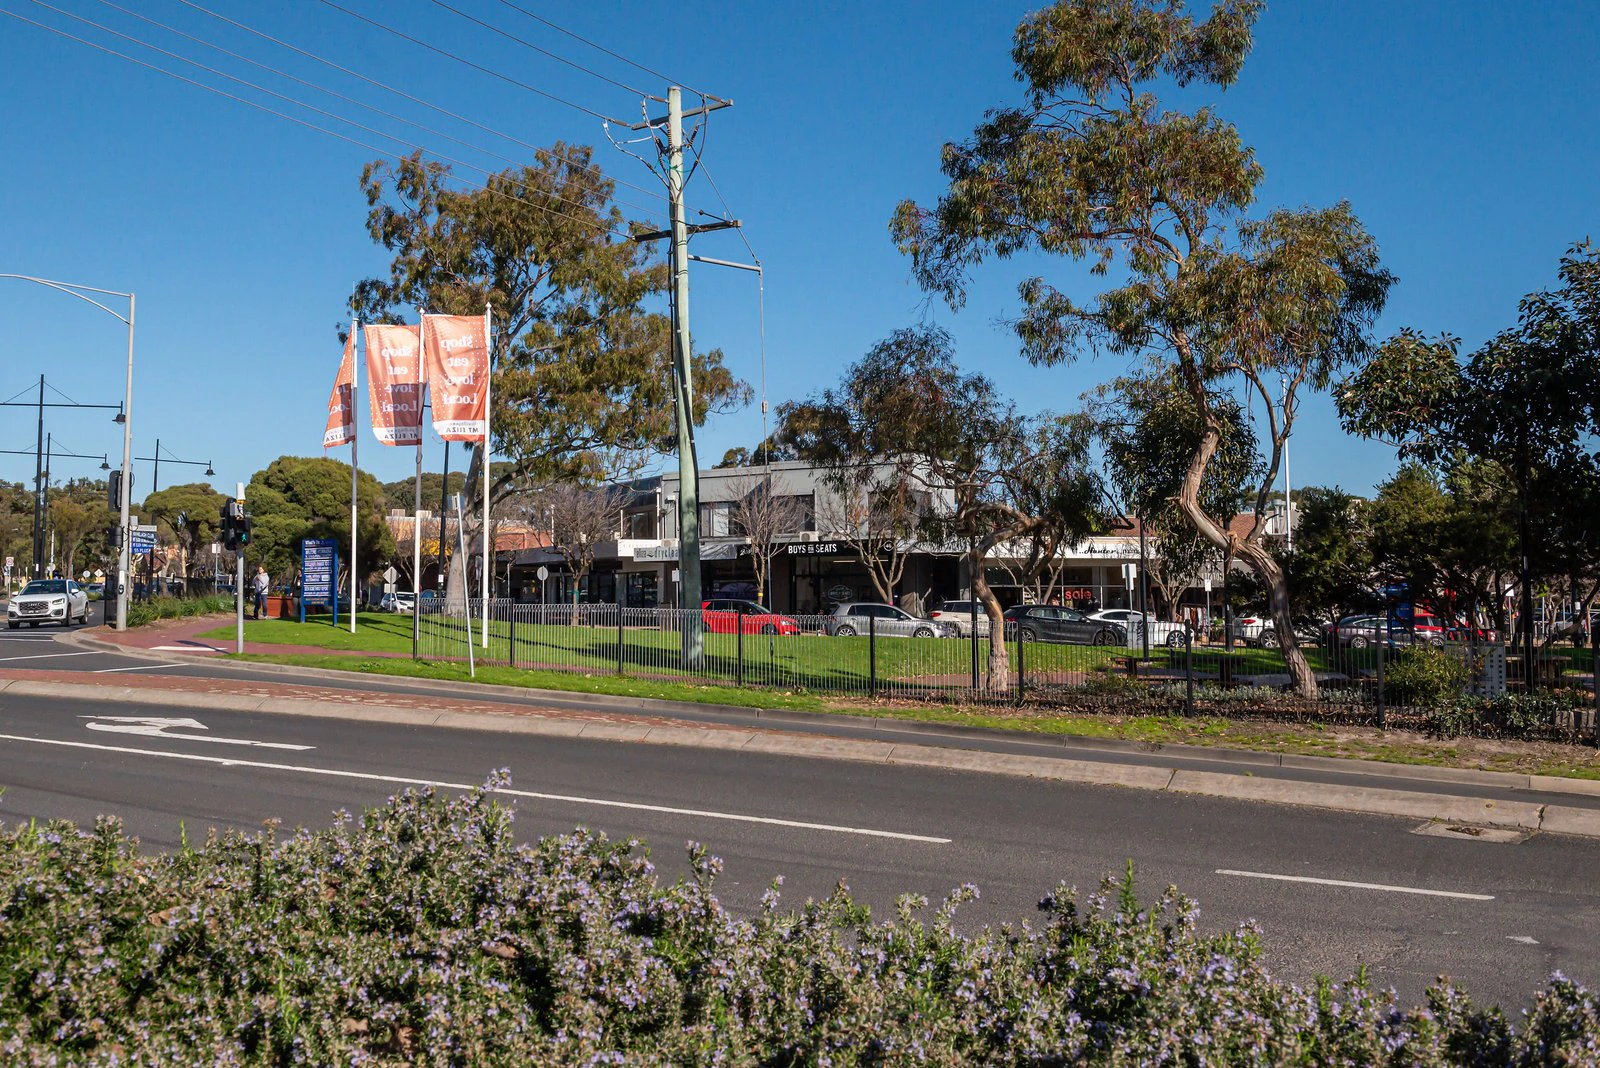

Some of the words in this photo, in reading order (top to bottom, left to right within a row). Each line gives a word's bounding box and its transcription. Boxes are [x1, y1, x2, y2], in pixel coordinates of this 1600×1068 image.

[655, 546, 678, 559] dryclea
[788, 545, 806, 554] BOYS
[816, 543, 837, 553] SEATS
[1065, 588, 1092, 599] sale
